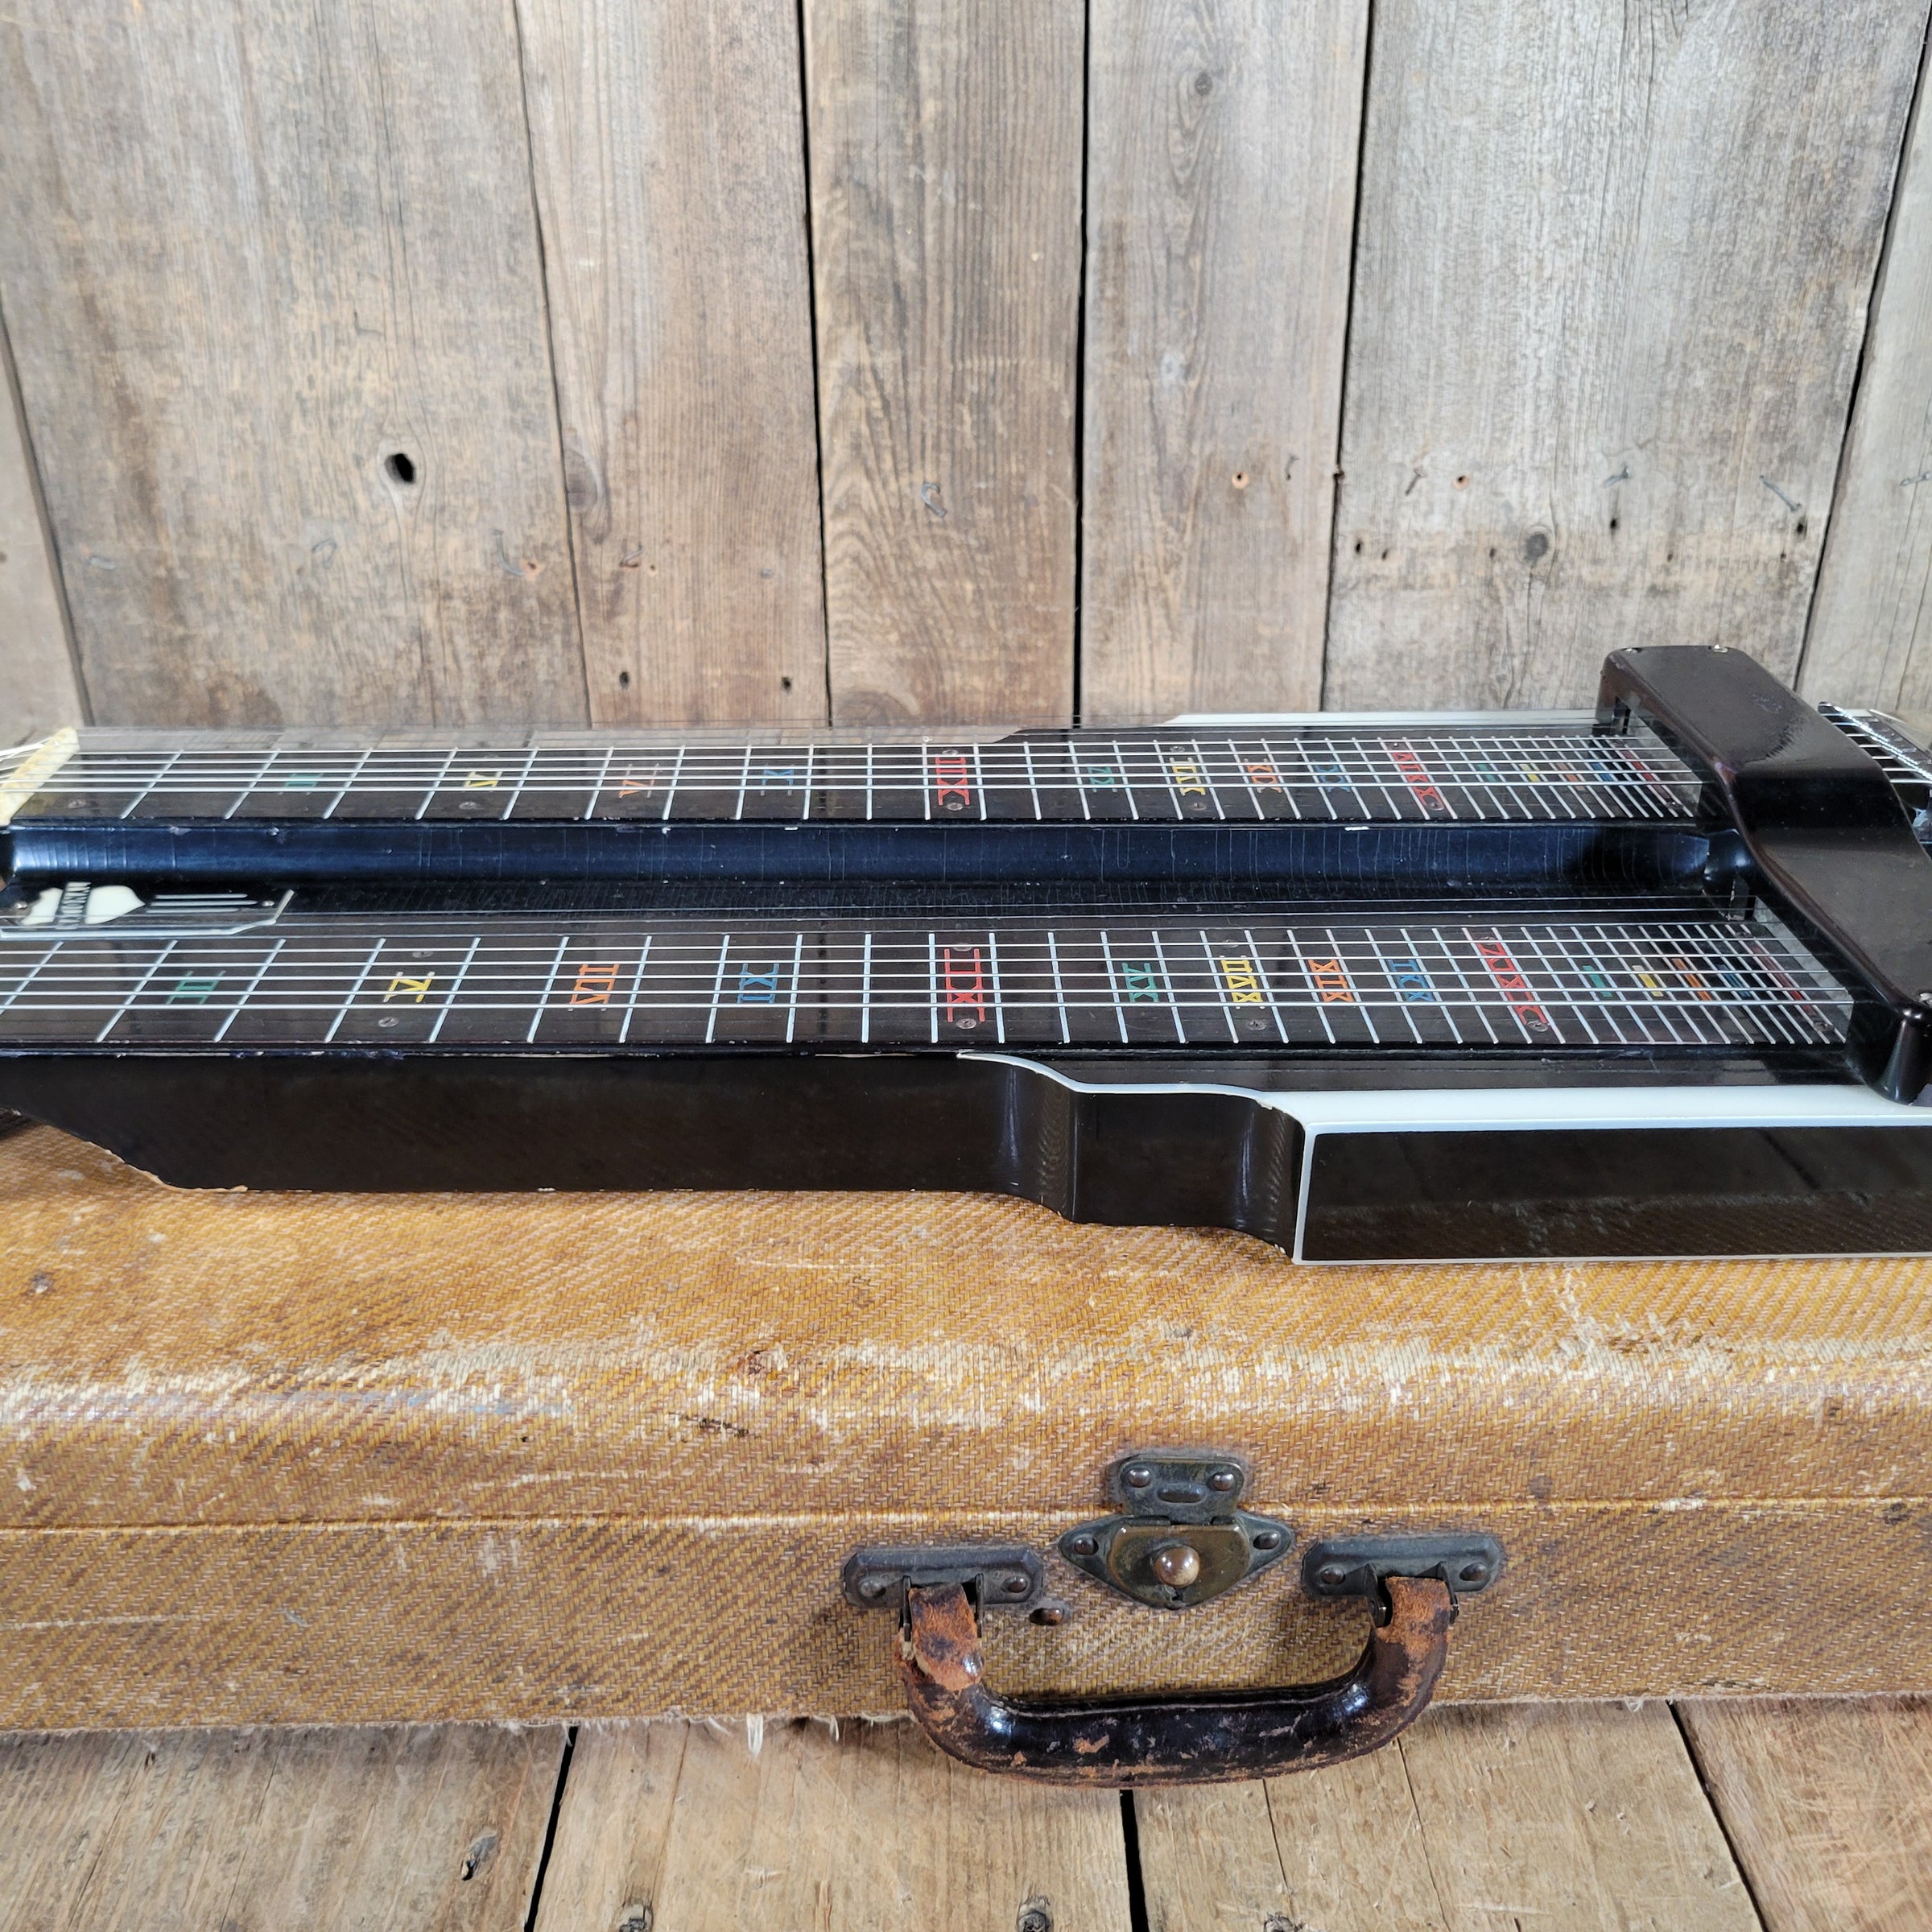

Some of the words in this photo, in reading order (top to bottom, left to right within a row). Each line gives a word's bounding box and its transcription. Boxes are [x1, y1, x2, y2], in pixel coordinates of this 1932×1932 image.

[935, 754, 970, 805] XII
[1087, 764, 1117, 793] XV
[1391, 750, 1445, 808] XXIV
[383, 971, 436, 1003] V
[567, 962, 621, 1011] VII
[737, 962, 780, 1005] IX
[1121, 962, 1160, 1003] XV
[1219, 955, 1266, 1009] XVII
[1307, 958, 1356, 1003] XIX
[1386, 958, 1436, 1003] XXI
[1476, 940, 1550, 1026] XXIV
